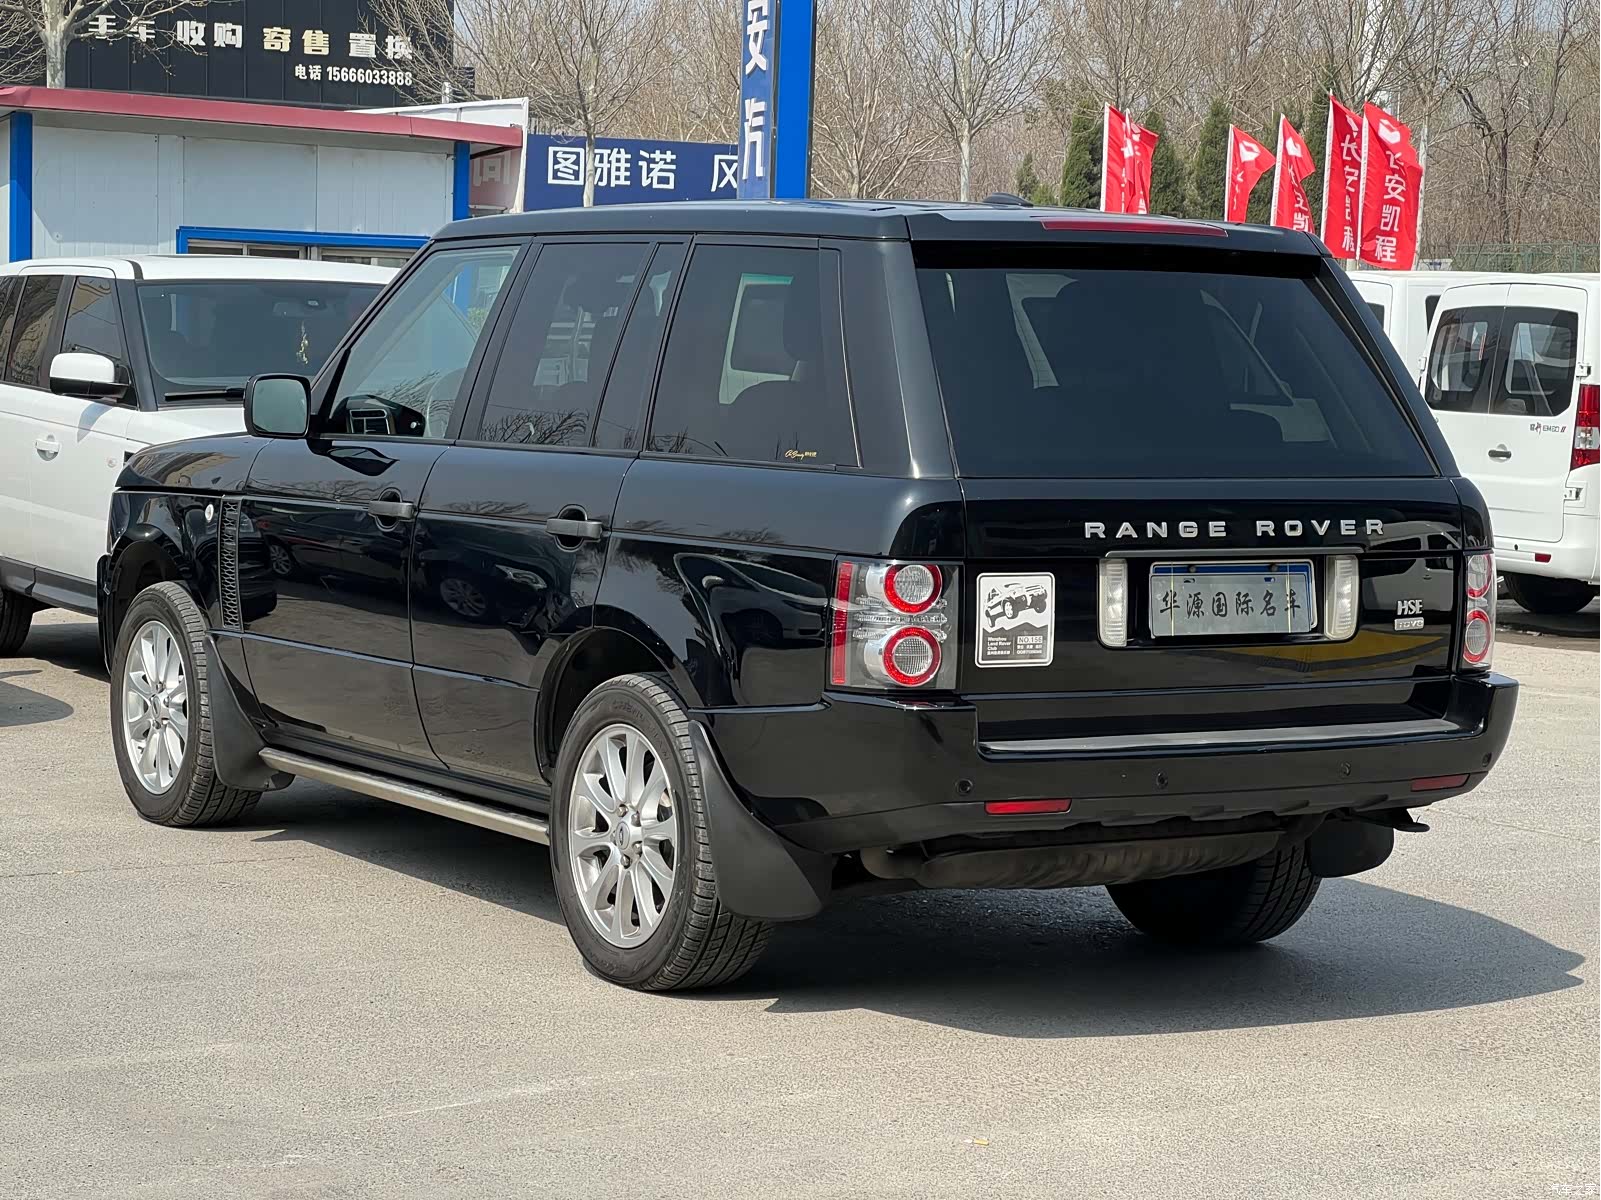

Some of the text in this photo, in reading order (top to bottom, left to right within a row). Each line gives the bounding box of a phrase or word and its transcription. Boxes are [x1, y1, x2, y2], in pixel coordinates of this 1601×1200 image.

[176, 20, 243, 48] 收购
[262, 27, 330, 56] 寄售
[349, 32, 413, 60] 置换
[294, 64, 413, 86] 电话 15666033888
[548, 146, 677, 190] 图雅诺
[1084, 519, 1384, 538] RANGE ROVER
[1159, 588, 1302, 621] 华源国际名车
[1397, 599, 1423, 616] HSE
